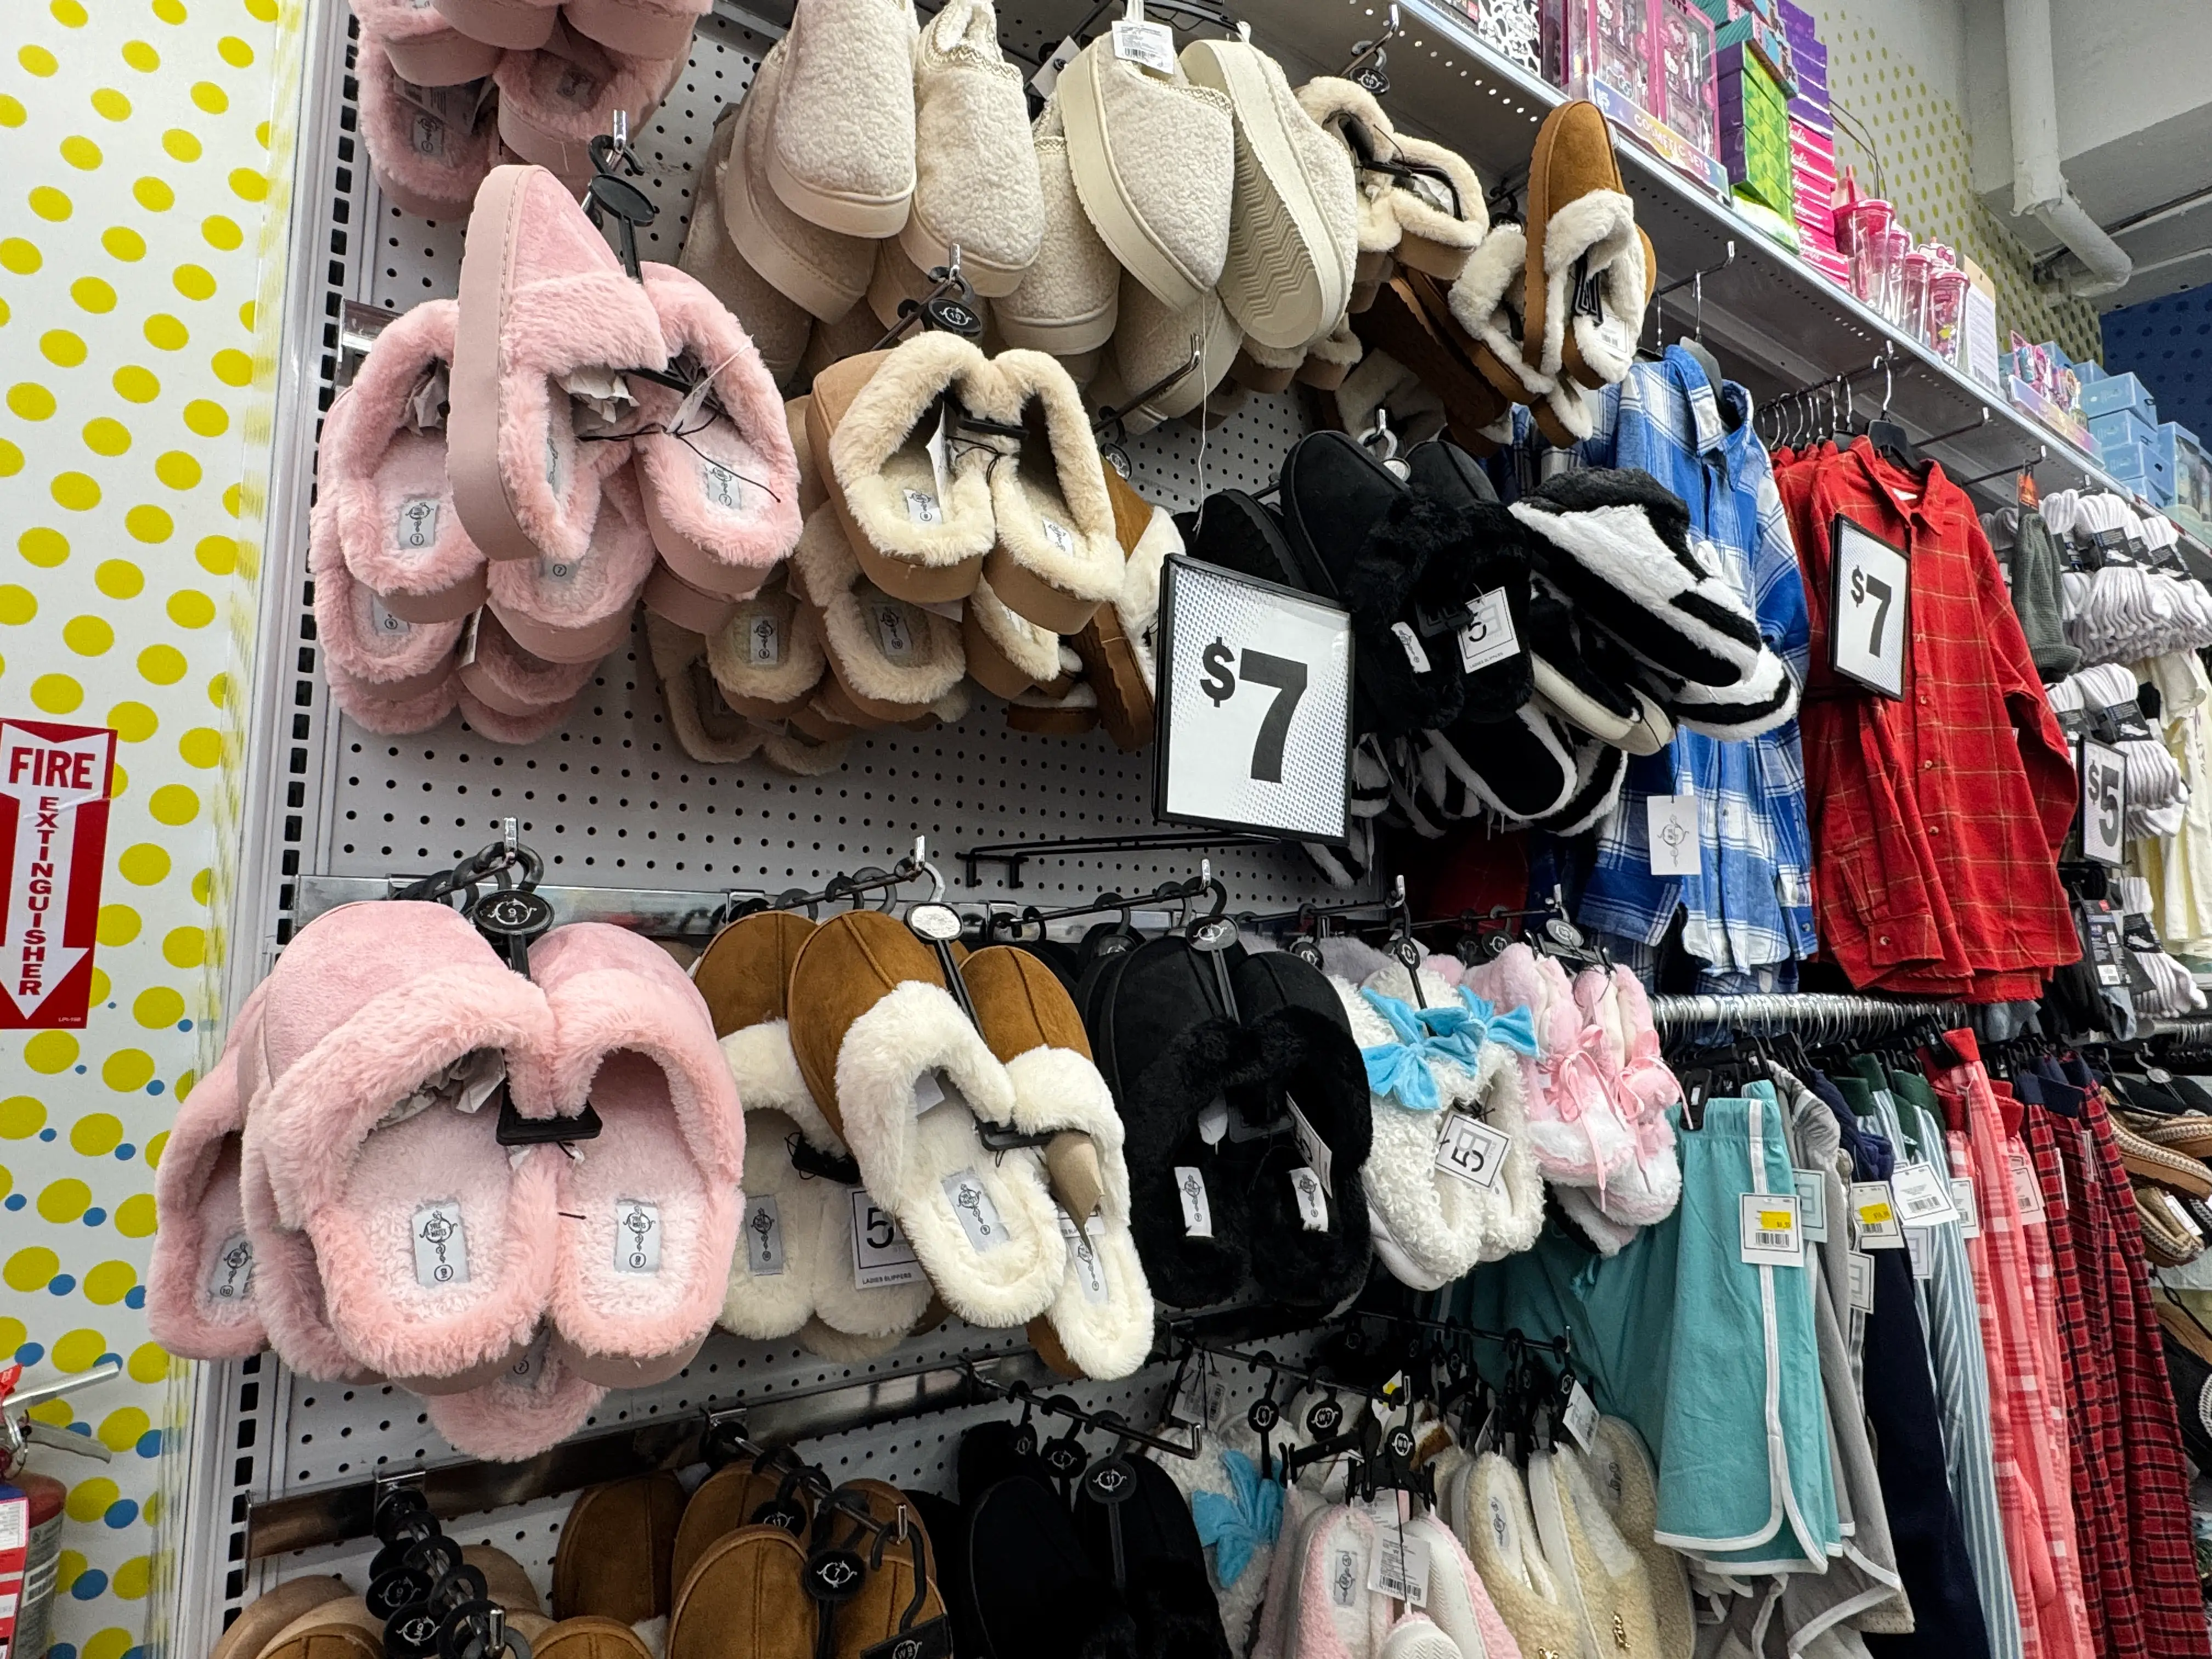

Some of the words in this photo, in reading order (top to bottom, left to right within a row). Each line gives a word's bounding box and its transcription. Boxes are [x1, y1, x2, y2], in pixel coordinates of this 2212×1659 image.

[1634, 113, 1686, 157] COSMETIC
[1688, 150, 1711, 176] SETS
[1851, 565, 1892, 658] $7
[1199, 636, 1308, 784] $7
[9, 746, 95, 791] FIRE
[2087, 760, 2119, 848] $5
[18, 796, 60, 996] EXTINGUISHER
[866, 1206, 894, 1249] 5
